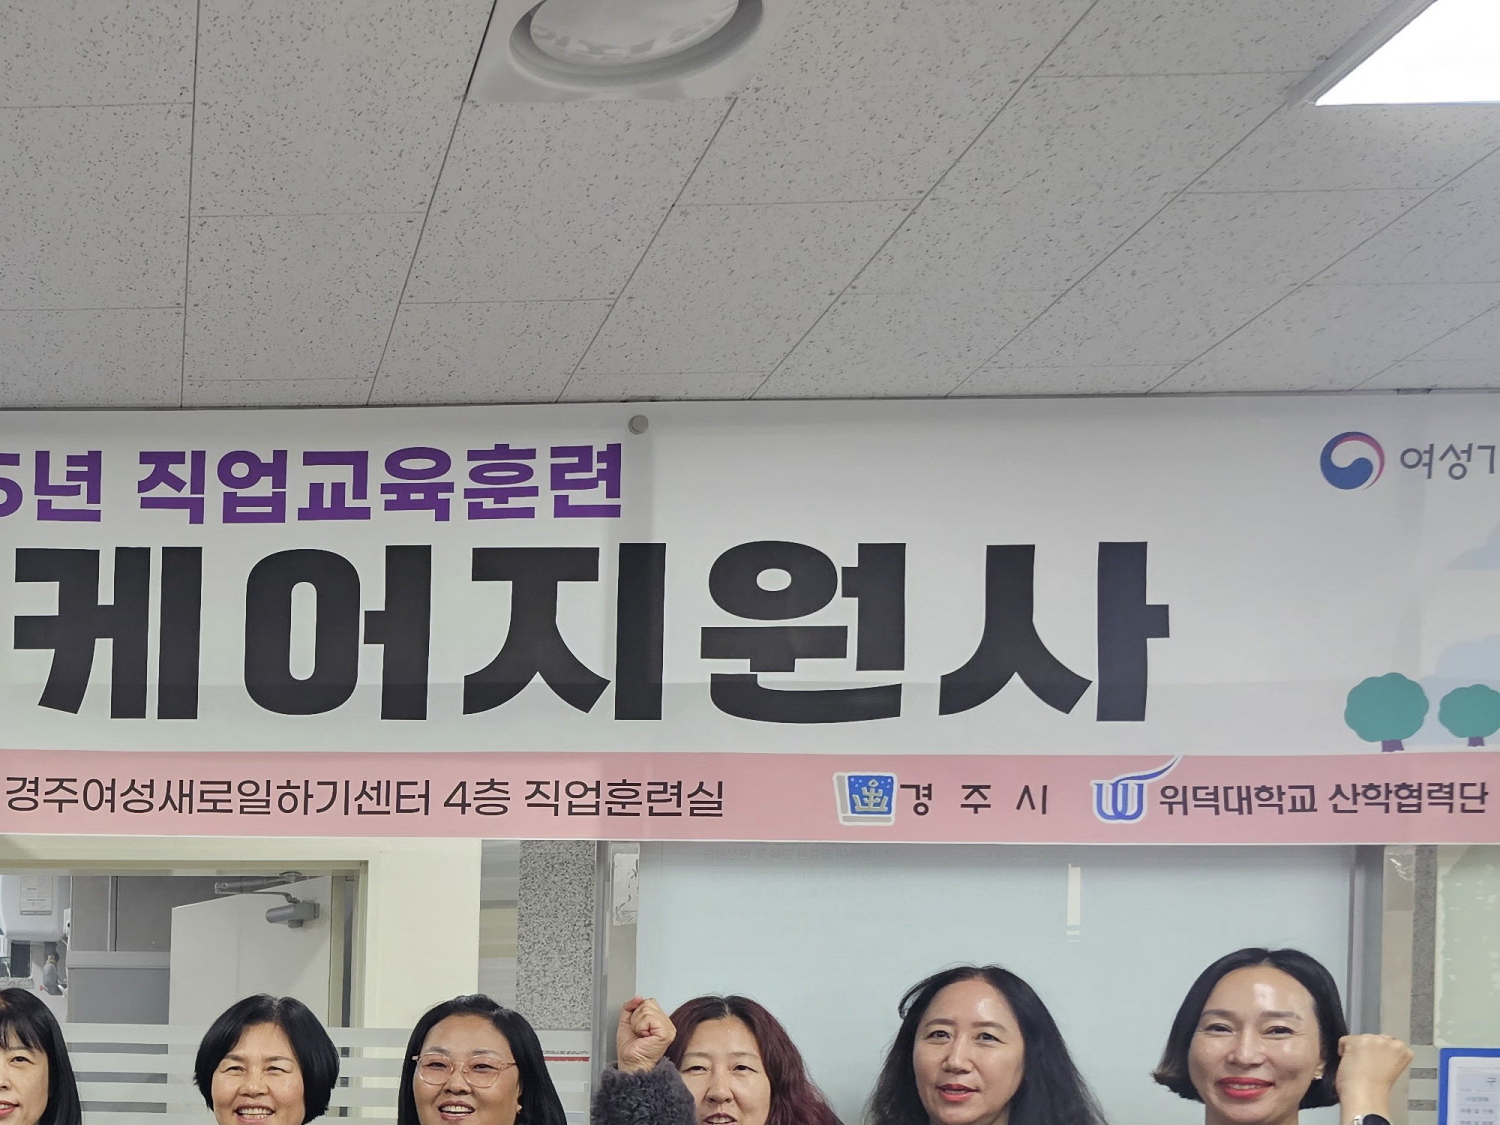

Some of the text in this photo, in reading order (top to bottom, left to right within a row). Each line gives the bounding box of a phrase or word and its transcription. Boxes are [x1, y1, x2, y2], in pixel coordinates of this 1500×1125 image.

[137, 443, 623, 524] 직업교육훈련
[13, 540, 1170, 724] 케어지원사
[4, 775, 431, 816] 경주여성새로일하기센터
[443, 777, 511, 816] 4층
[523, 778, 724, 817] 직업훈련실
[1159, 781, 1489, 816] 위덕대학교 산학협력단
